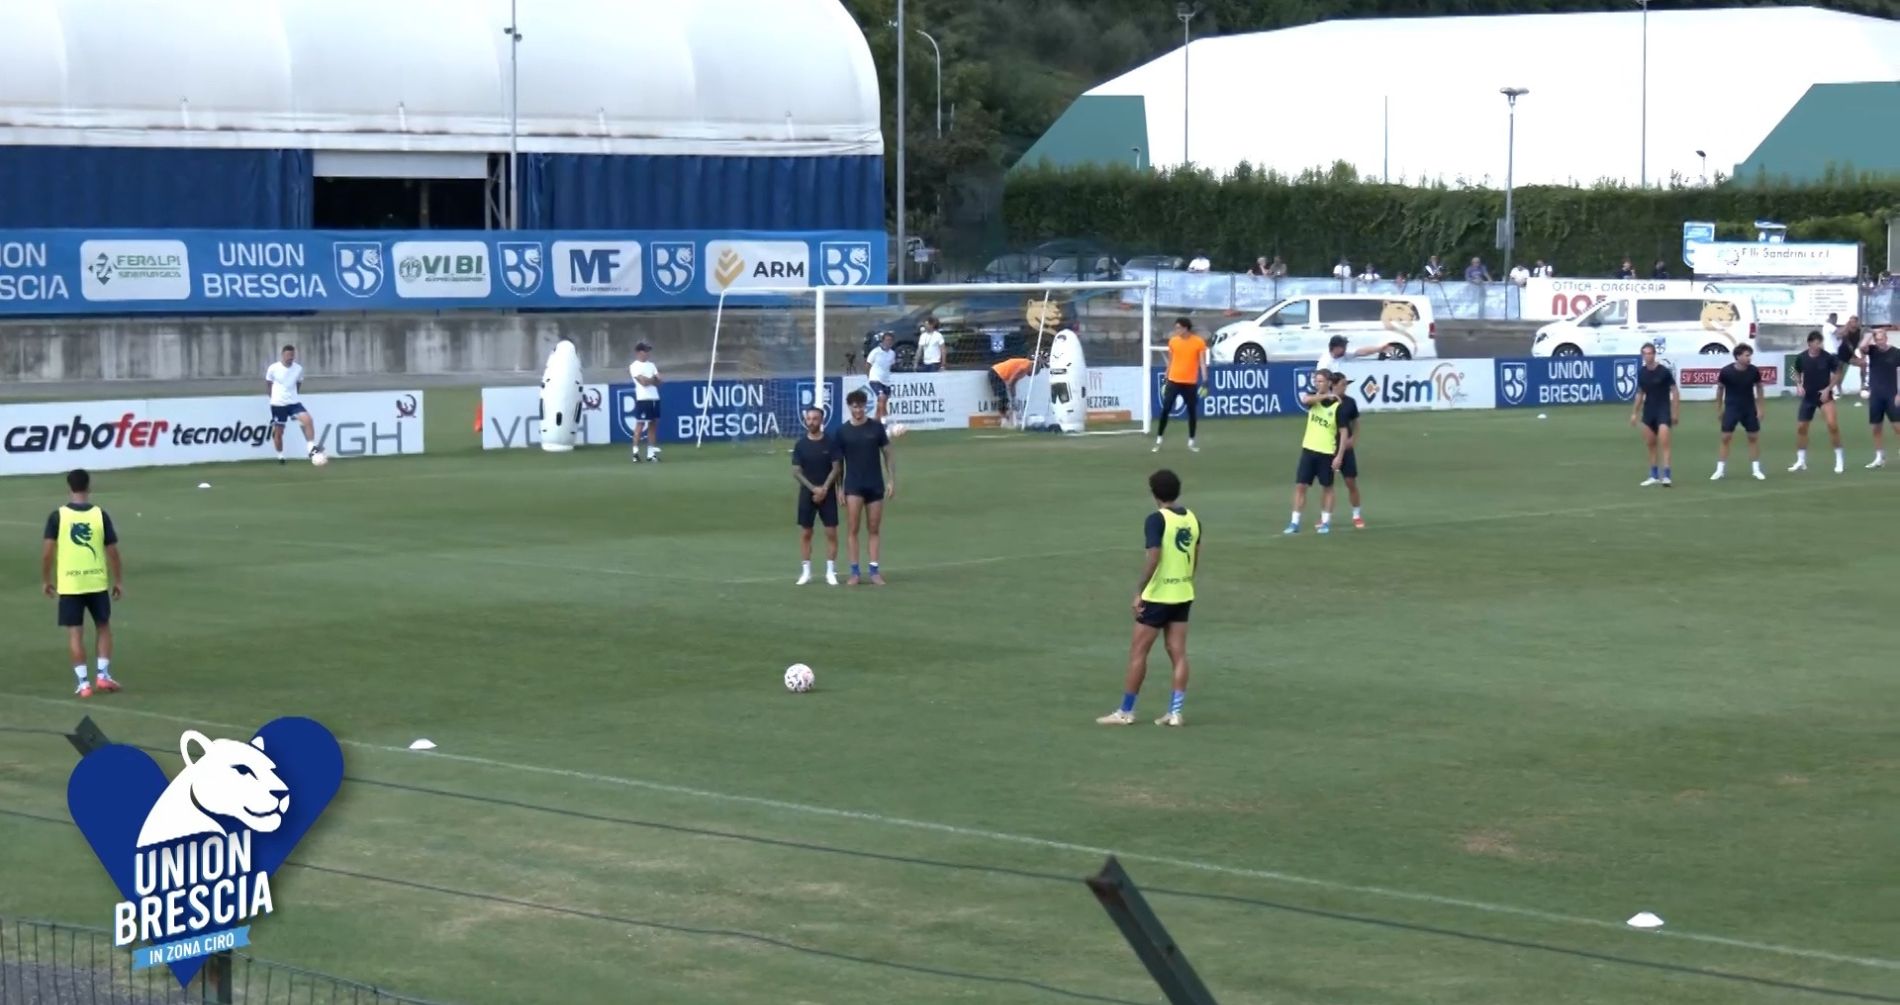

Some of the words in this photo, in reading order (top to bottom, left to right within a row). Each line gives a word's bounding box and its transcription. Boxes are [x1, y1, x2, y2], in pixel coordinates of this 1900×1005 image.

[0, 242, 47, 268] ON
[117, 254, 182, 267] FERALPI
[218, 241, 304, 267] UNION
[1763, 247, 1807, 259] Sandrini
[569, 249, 621, 284] MF
[753, 261, 805, 278] ARM
[202, 273, 328, 298] BRESCIA
[1215, 369, 1269, 389] UNION
[1548, 360, 1594, 379] UNION
[1693, 372, 1720, 383] SISTEM
[692, 384, 764, 408] UNION
[889, 382, 936, 397] RIANNA
[1539, 383, 1603, 403] BRESCIA
[889, 399, 945, 414] MBIENTE
[1204, 394, 1281, 416] BRESCIA
[4, 412, 169, 453] carbofer
[172, 420, 276, 446] tecnologi
[677, 412, 780, 438] BRESCIA
